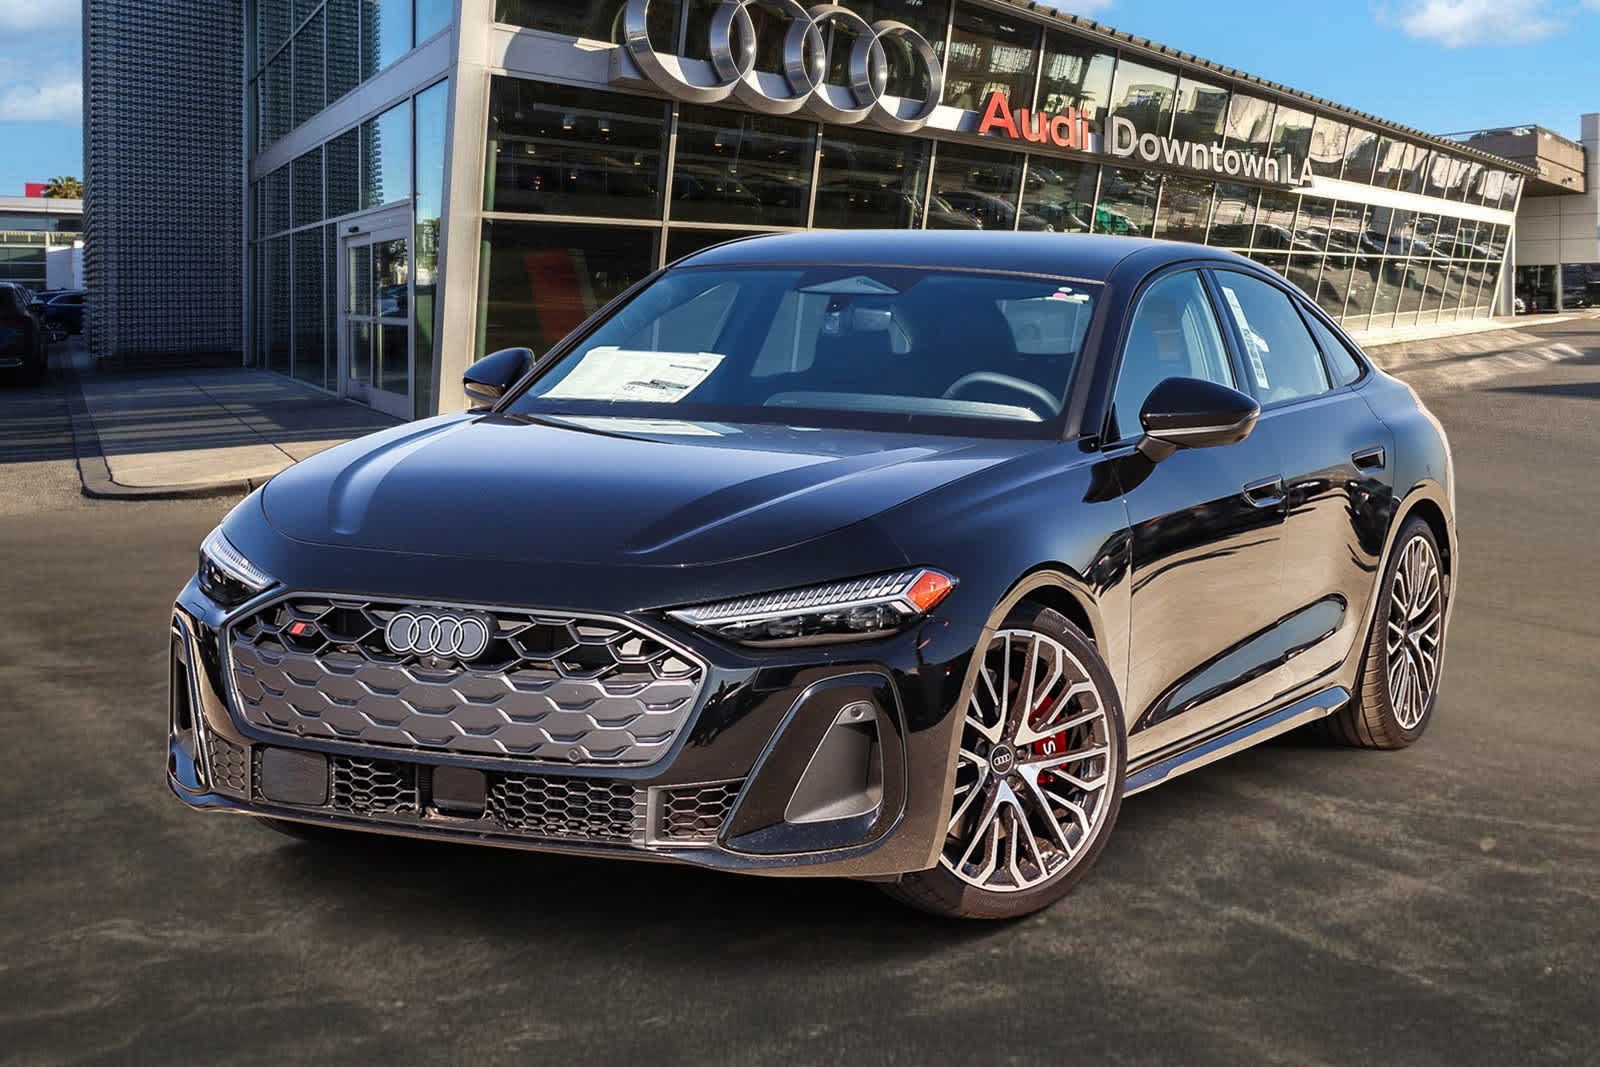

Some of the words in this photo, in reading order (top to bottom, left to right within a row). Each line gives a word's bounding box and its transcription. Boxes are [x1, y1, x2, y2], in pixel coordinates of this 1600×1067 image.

[977, 91, 1089, 150] Audi
[1106, 115, 1279, 183] Downtown
[1286, 152, 1314, 188] LA
